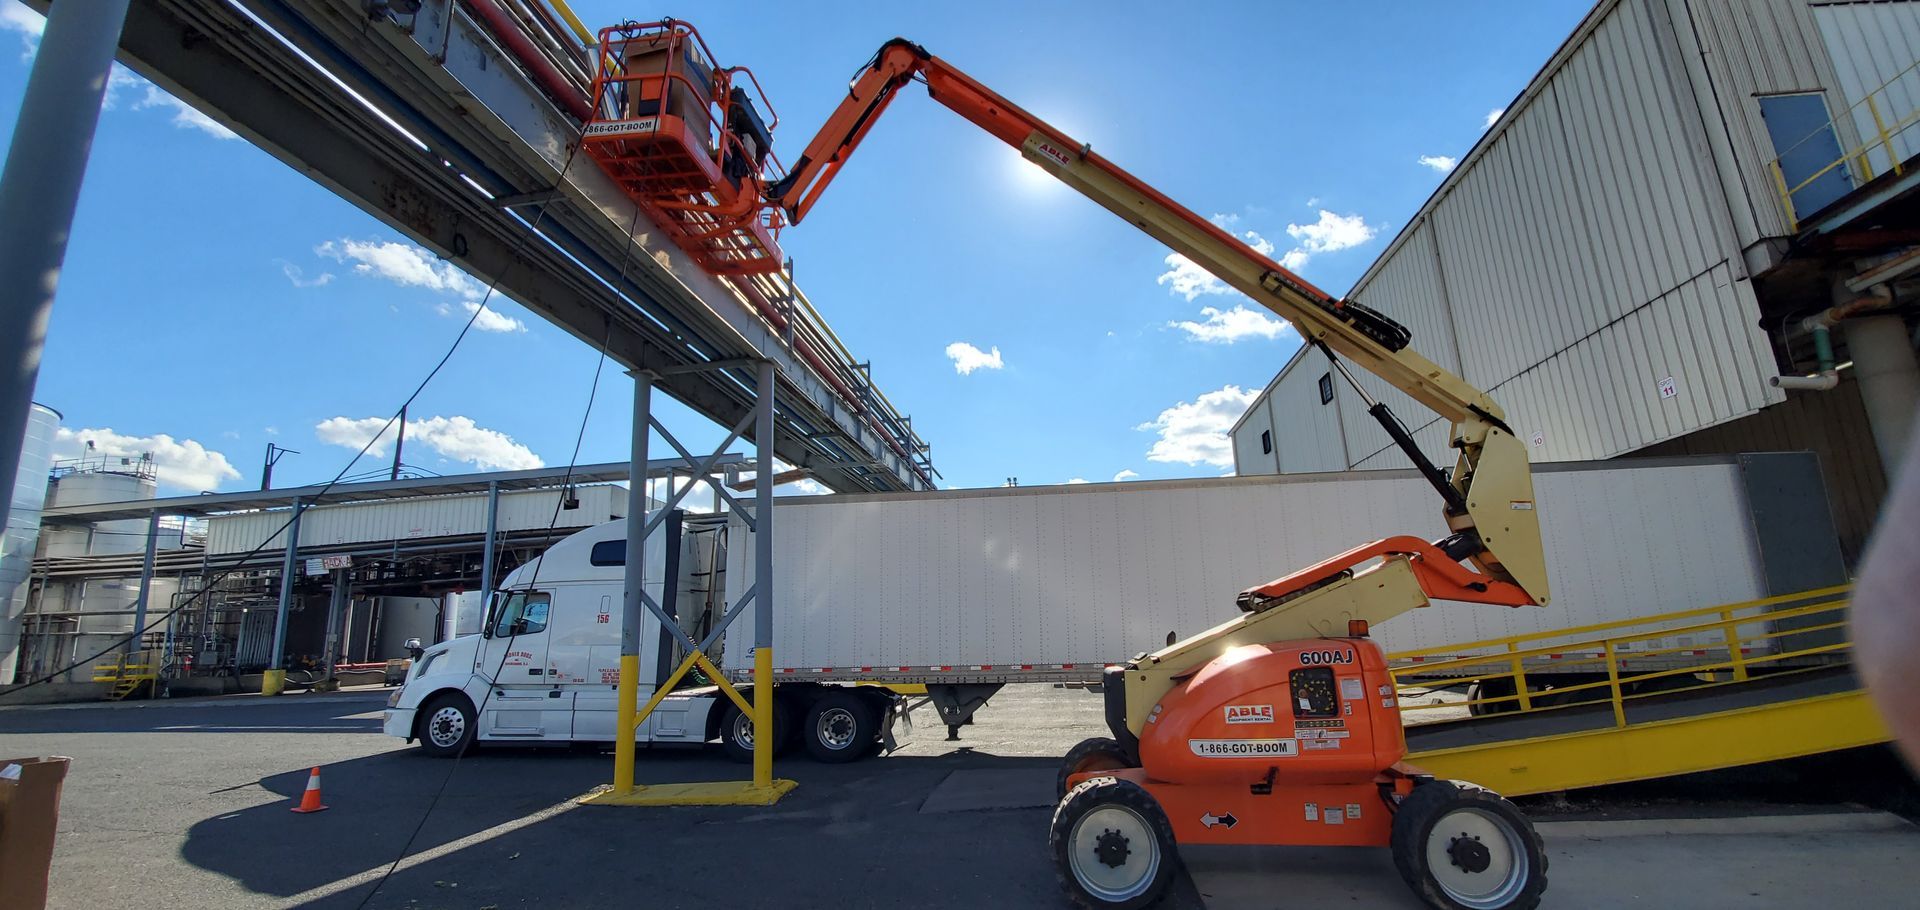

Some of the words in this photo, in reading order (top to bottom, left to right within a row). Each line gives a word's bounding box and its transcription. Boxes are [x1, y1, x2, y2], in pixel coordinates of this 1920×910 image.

[582, 121, 652, 134] -866-GOT-BOOM
[1664, 386, 1674, 396] 11
[1534, 437, 1543, 446] 10
[597, 614, 610, 624] 156
[1300, 649, 1353, 665] 600AJ
[1227, 706, 1272, 718] ABLE
[1199, 742, 1288, 754] 1-866-GOT-BOOM
